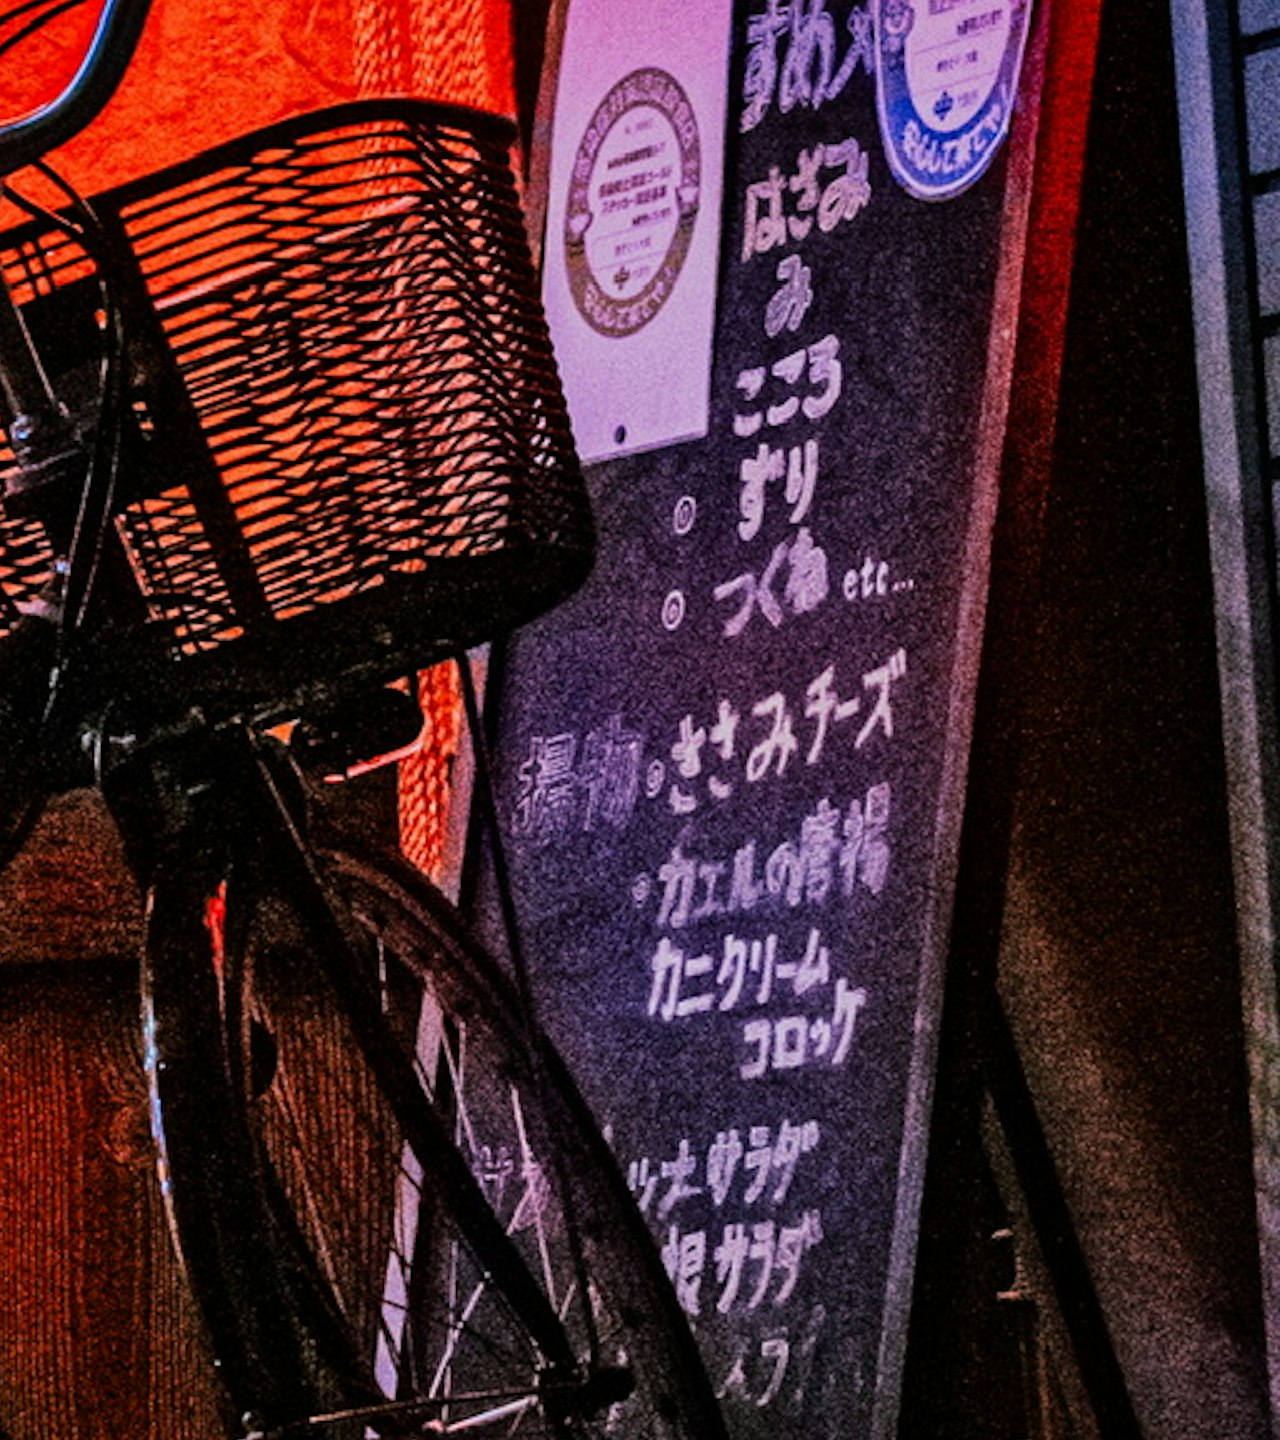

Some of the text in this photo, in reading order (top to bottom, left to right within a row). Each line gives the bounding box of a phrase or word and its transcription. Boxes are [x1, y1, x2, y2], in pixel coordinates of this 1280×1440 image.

[732, 333, 842, 438] こころ
[737, 438, 819, 542] ずり
[713, 526, 829, 638] つくね
[670, 646, 908, 815] ささみチーズ
[646, 927, 830, 1021] カニクリーム
[740, 976, 867, 1080] コロッケ
